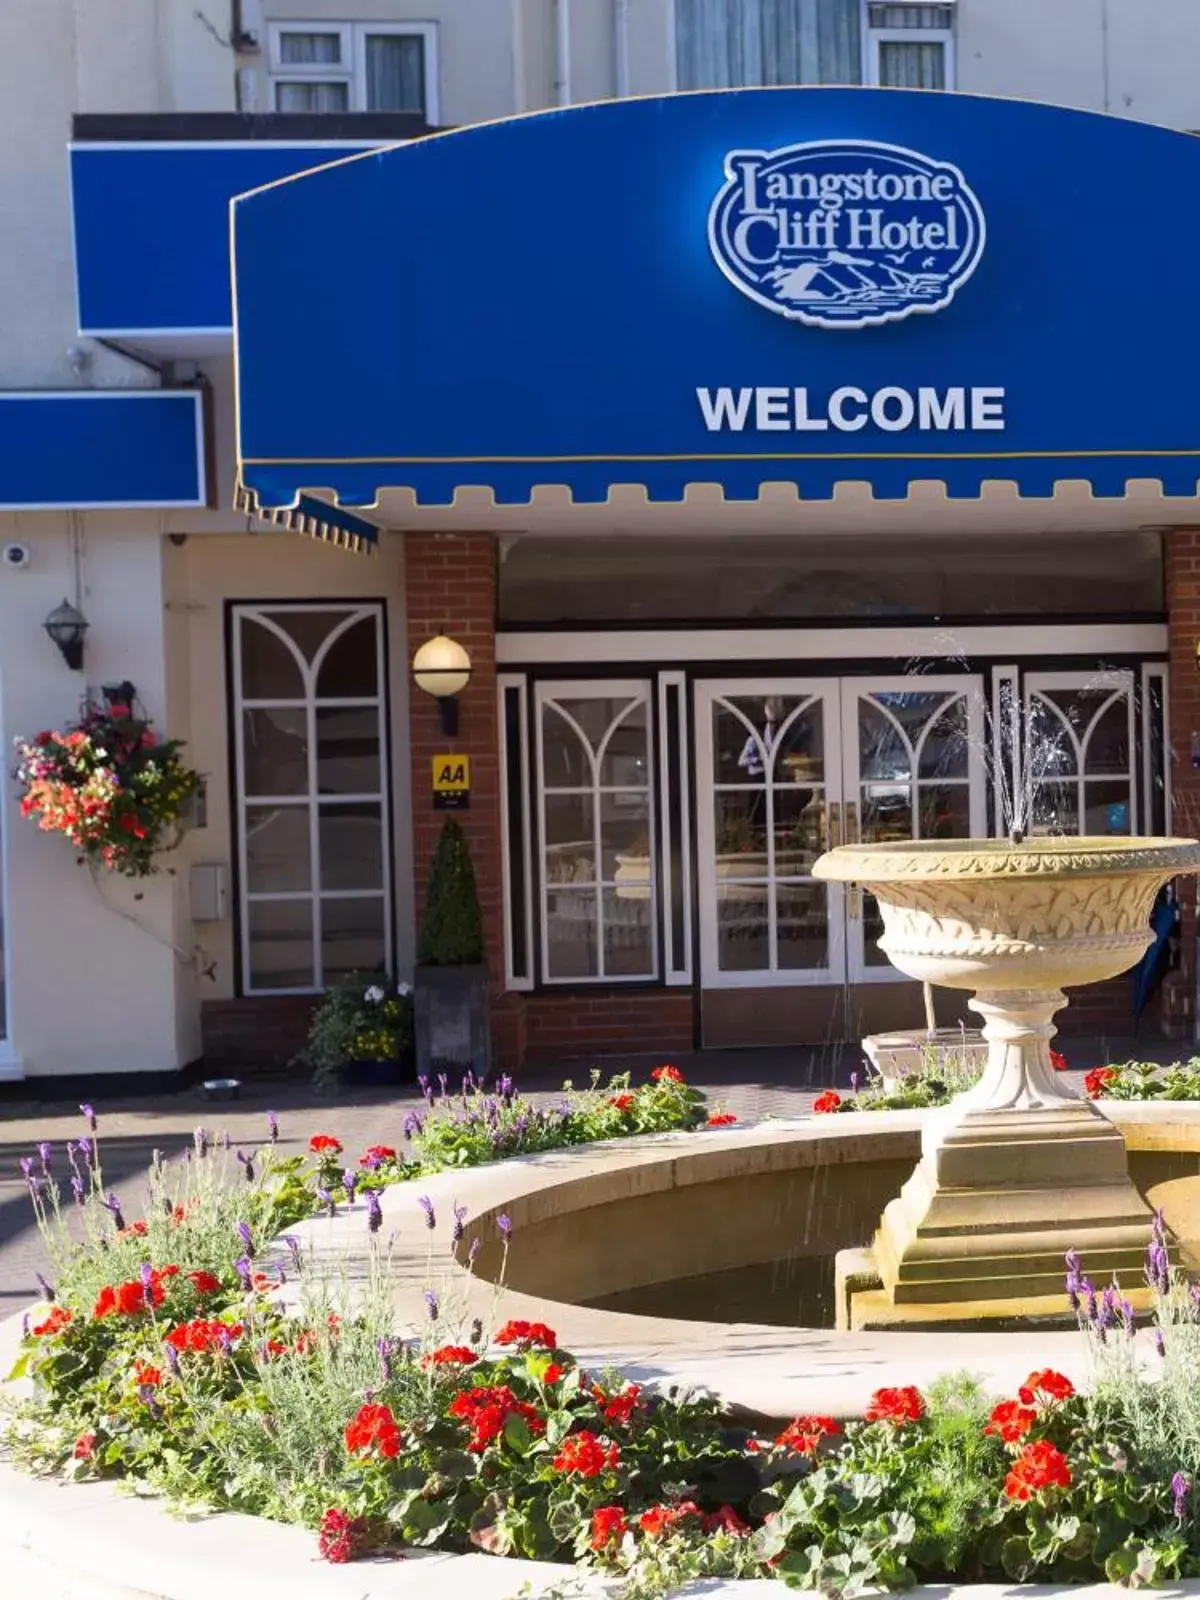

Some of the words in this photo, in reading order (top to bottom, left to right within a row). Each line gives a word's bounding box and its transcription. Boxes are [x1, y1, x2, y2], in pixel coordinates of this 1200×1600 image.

[736, 162, 954, 214] Langstone
[733, 208, 841, 264] Cliff
[847, 206, 960, 251] Hotel
[696, 387, 1006, 431] WELCOME
[437, 763, 465, 784] AA
